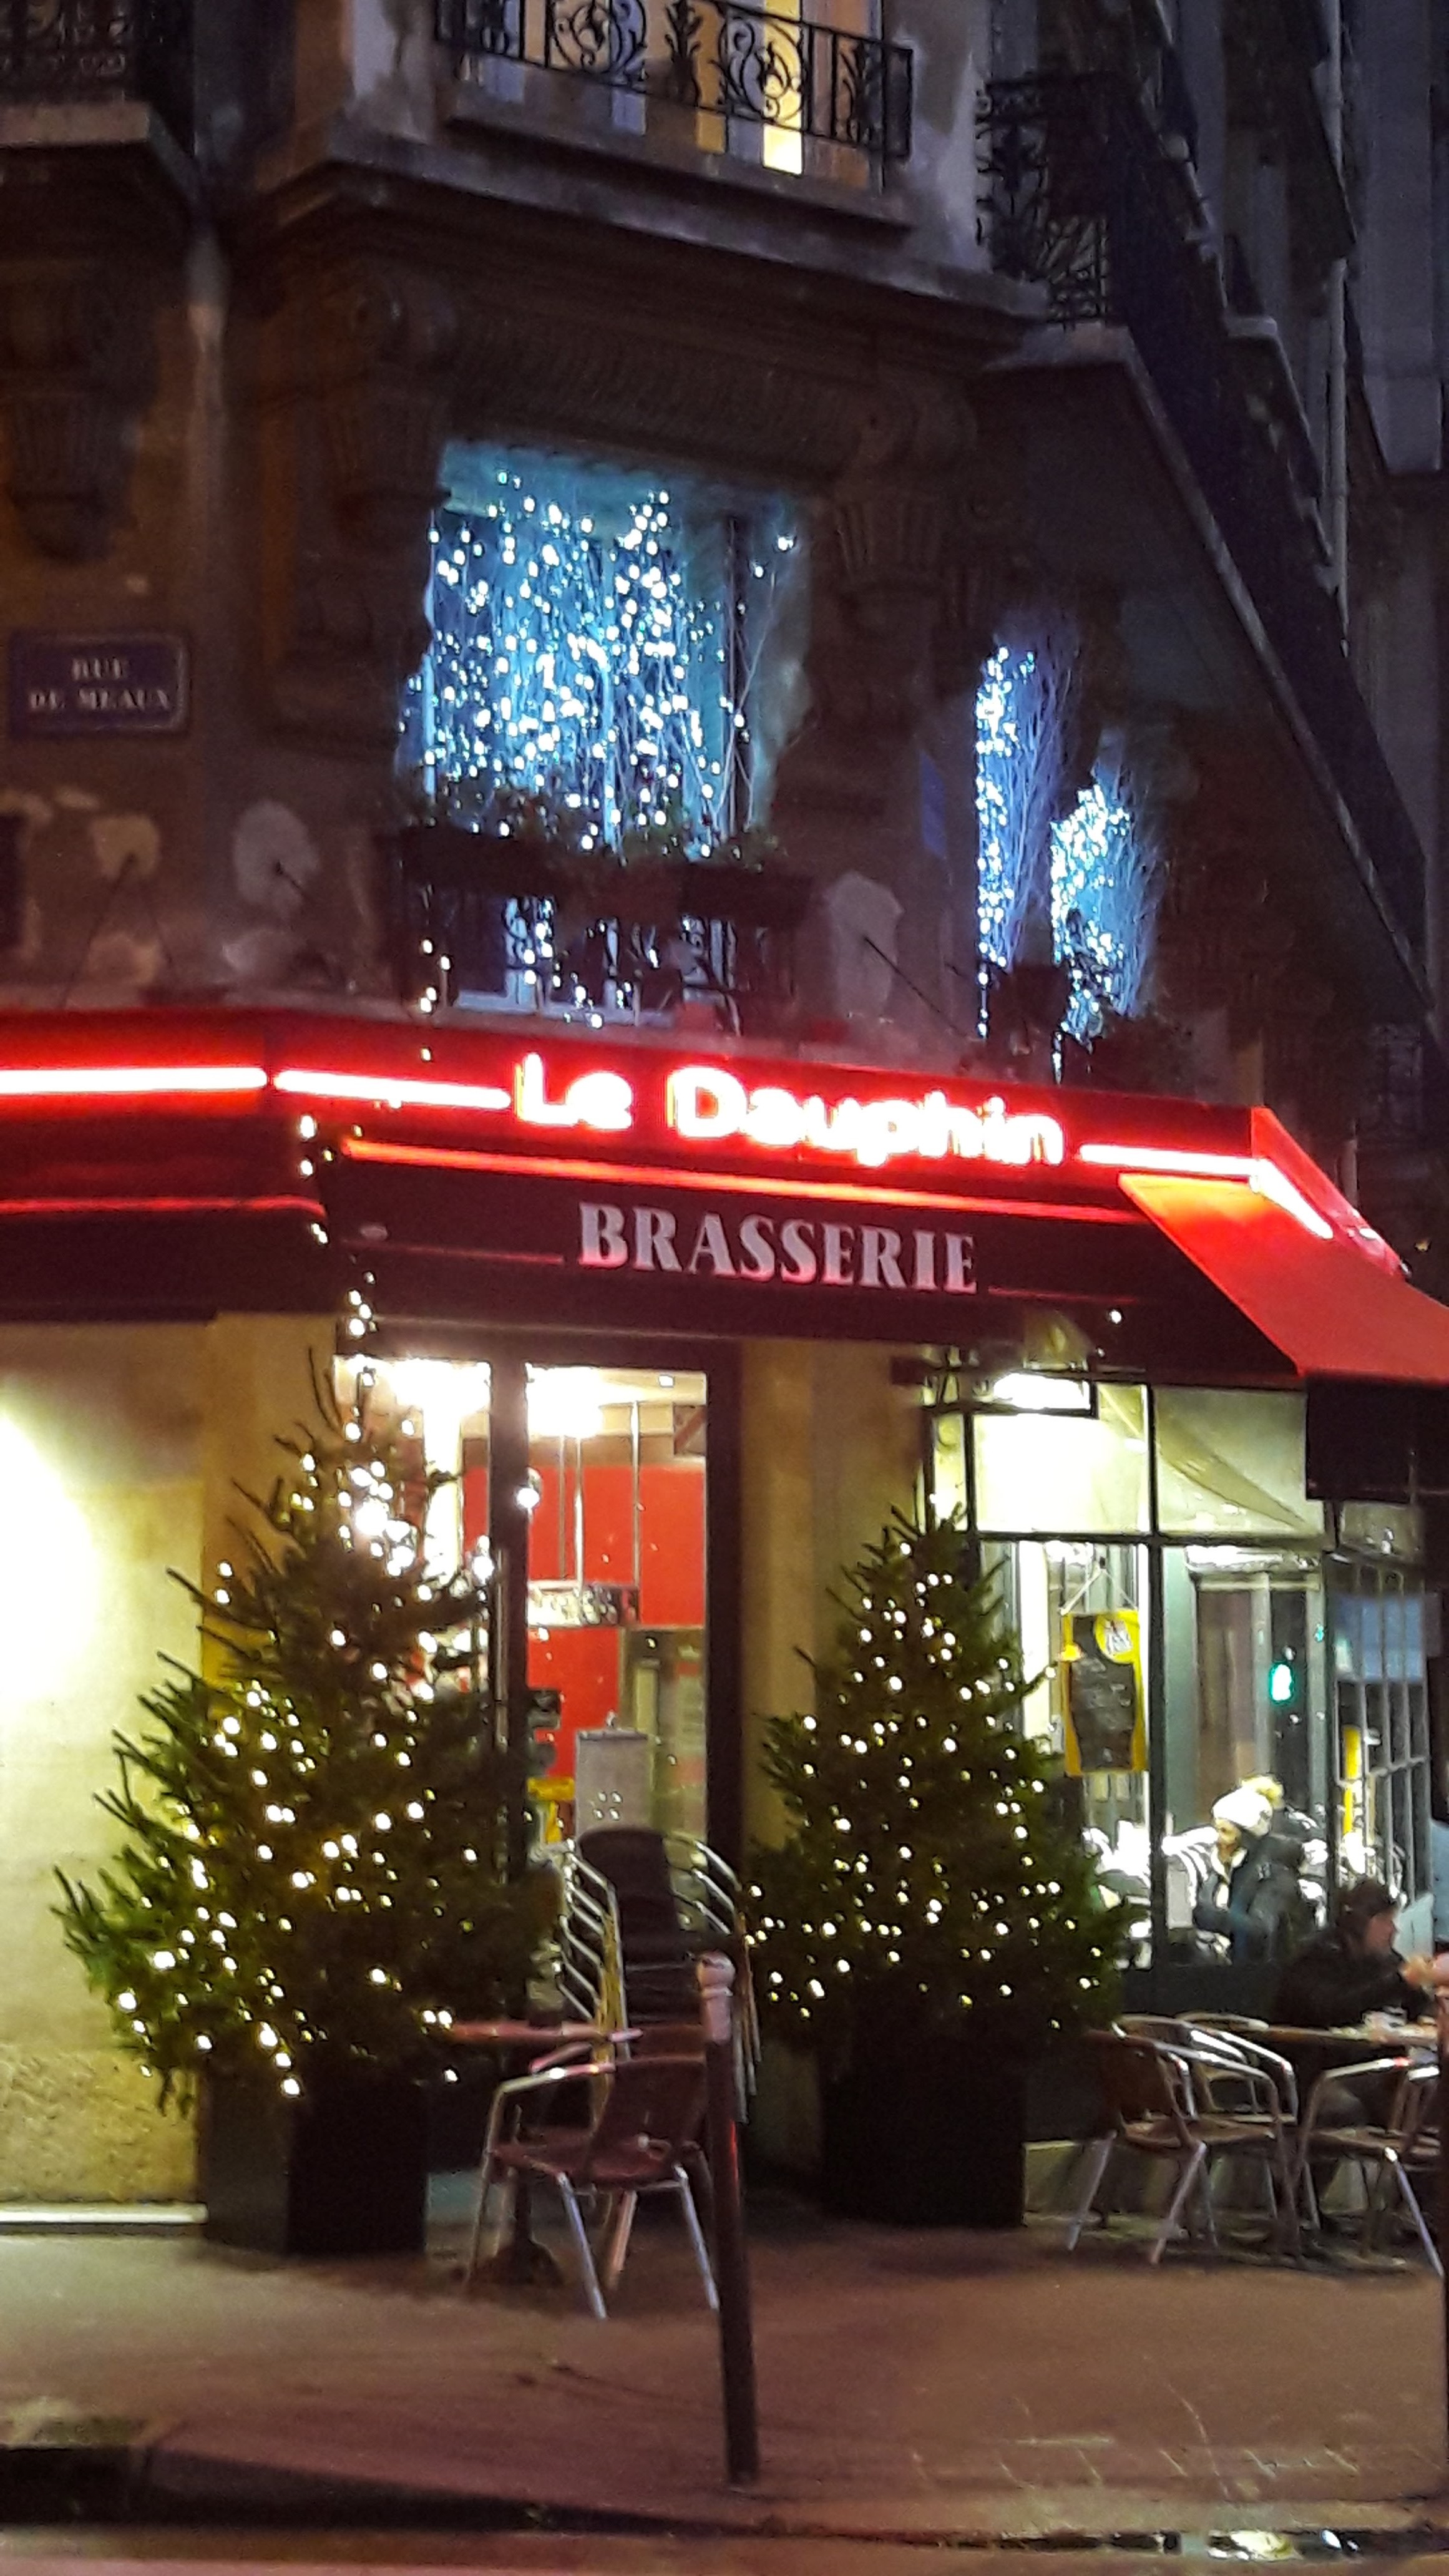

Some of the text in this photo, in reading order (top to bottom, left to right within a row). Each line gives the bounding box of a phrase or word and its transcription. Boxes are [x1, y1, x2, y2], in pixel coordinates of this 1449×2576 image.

[71, 657, 129, 680] RUE
[515, 1051, 1065, 1167] Le Dauphin
[578, 1202, 978, 1295] BRASSERIE
